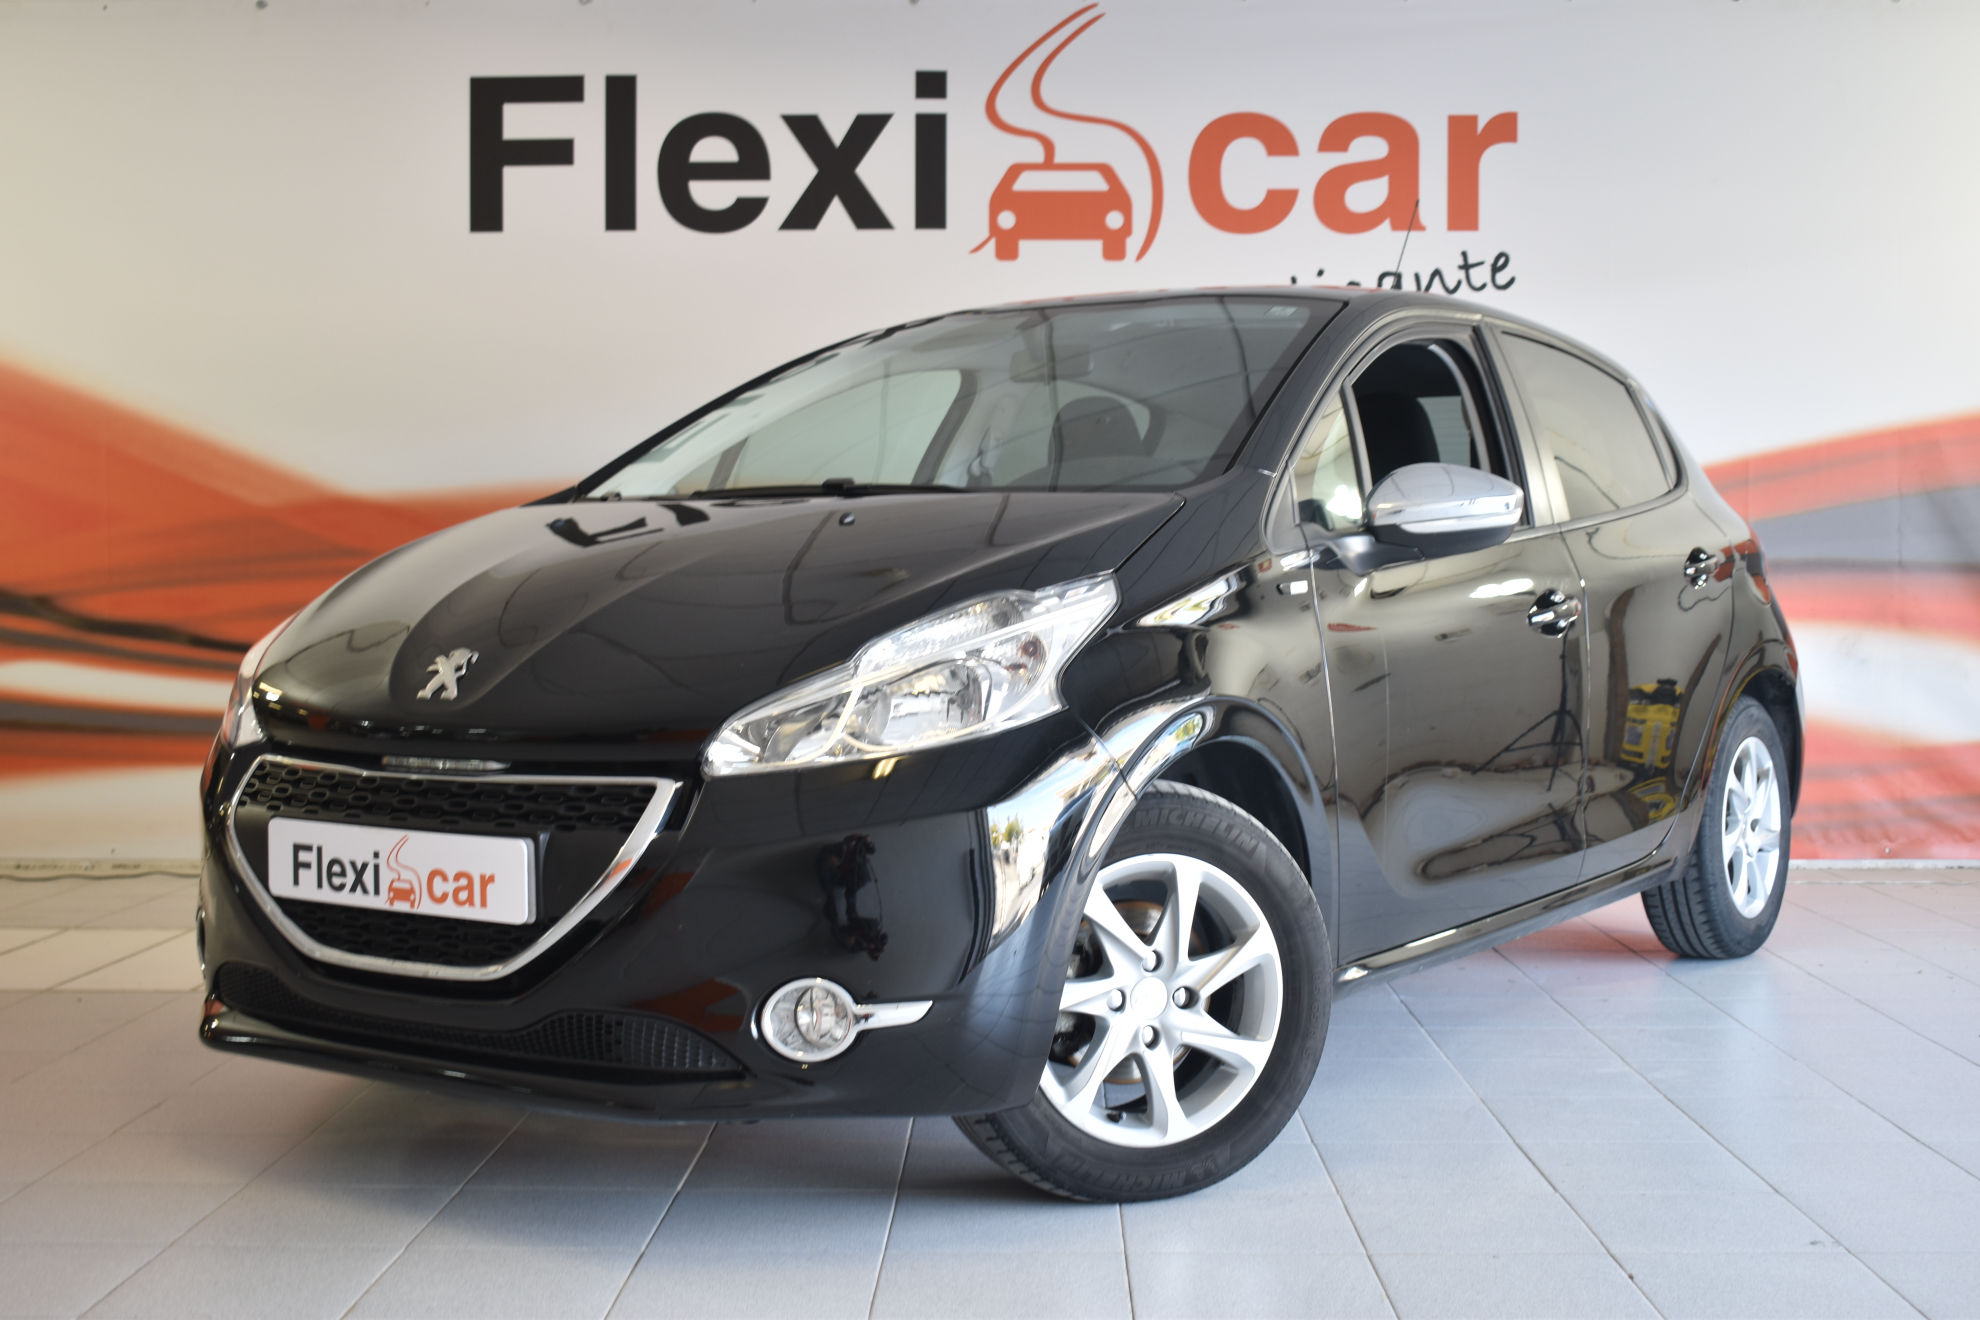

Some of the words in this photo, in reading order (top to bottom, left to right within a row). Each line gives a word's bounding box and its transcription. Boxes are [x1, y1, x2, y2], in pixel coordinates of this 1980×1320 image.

[470, 70, 948, 234] Flexi
[1187, 111, 1519, 235] car
[1136, 808, 1260, 857] MICHELIN
[292, 842, 381, 896] Flexi
[426, 867, 496, 909] car
